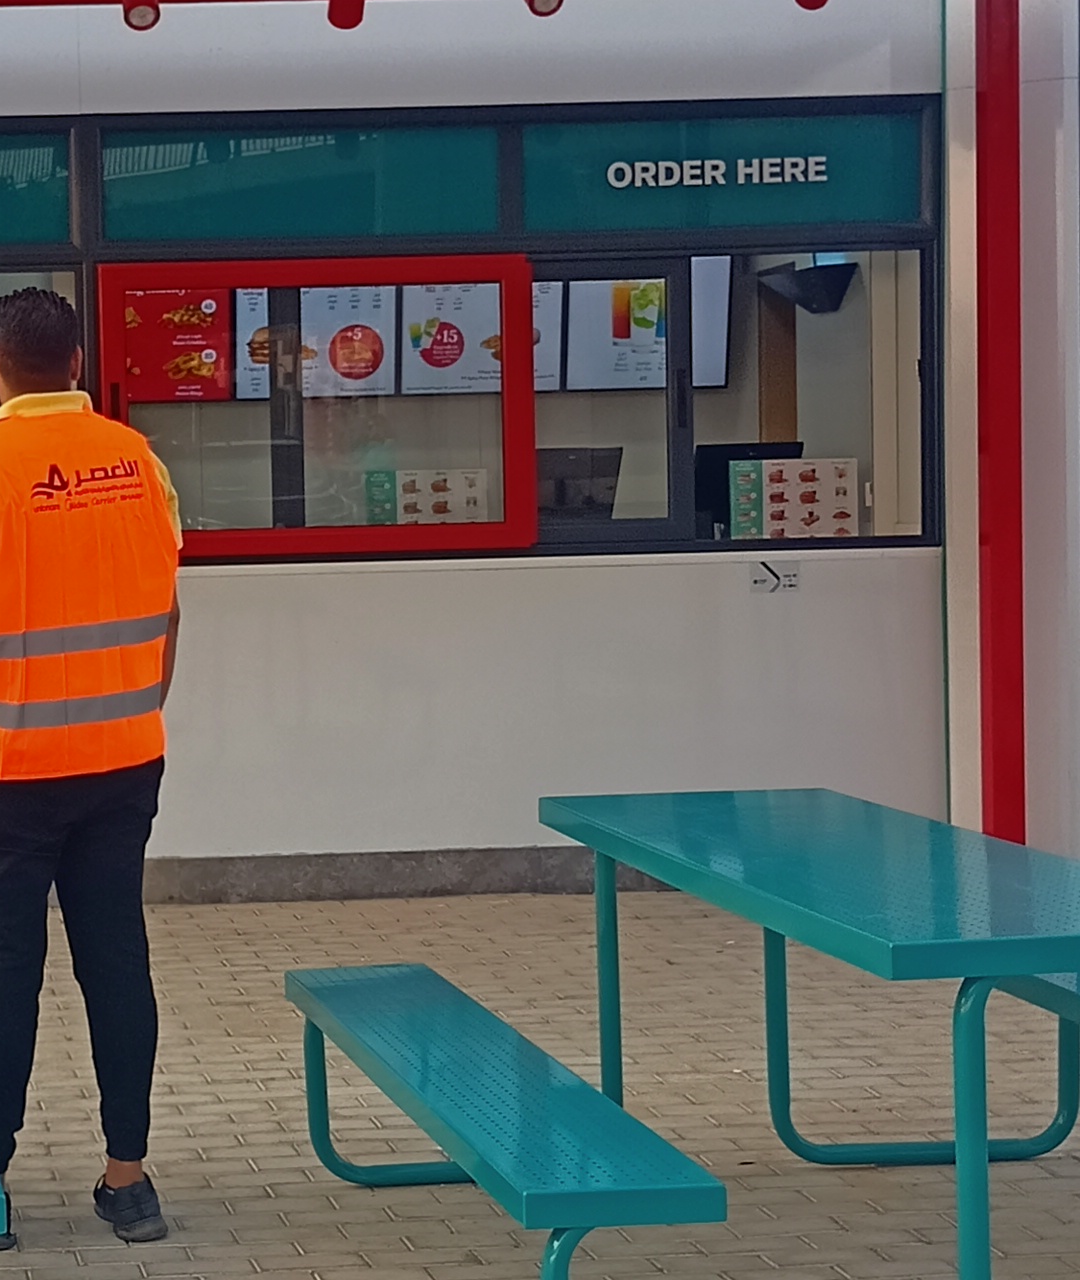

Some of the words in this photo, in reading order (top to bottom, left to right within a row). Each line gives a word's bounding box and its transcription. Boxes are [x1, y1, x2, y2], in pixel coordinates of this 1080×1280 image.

[606, 160, 726, 189] ORDER
[736, 156, 828, 184] HERE
[435, 329, 458, 343] +15
